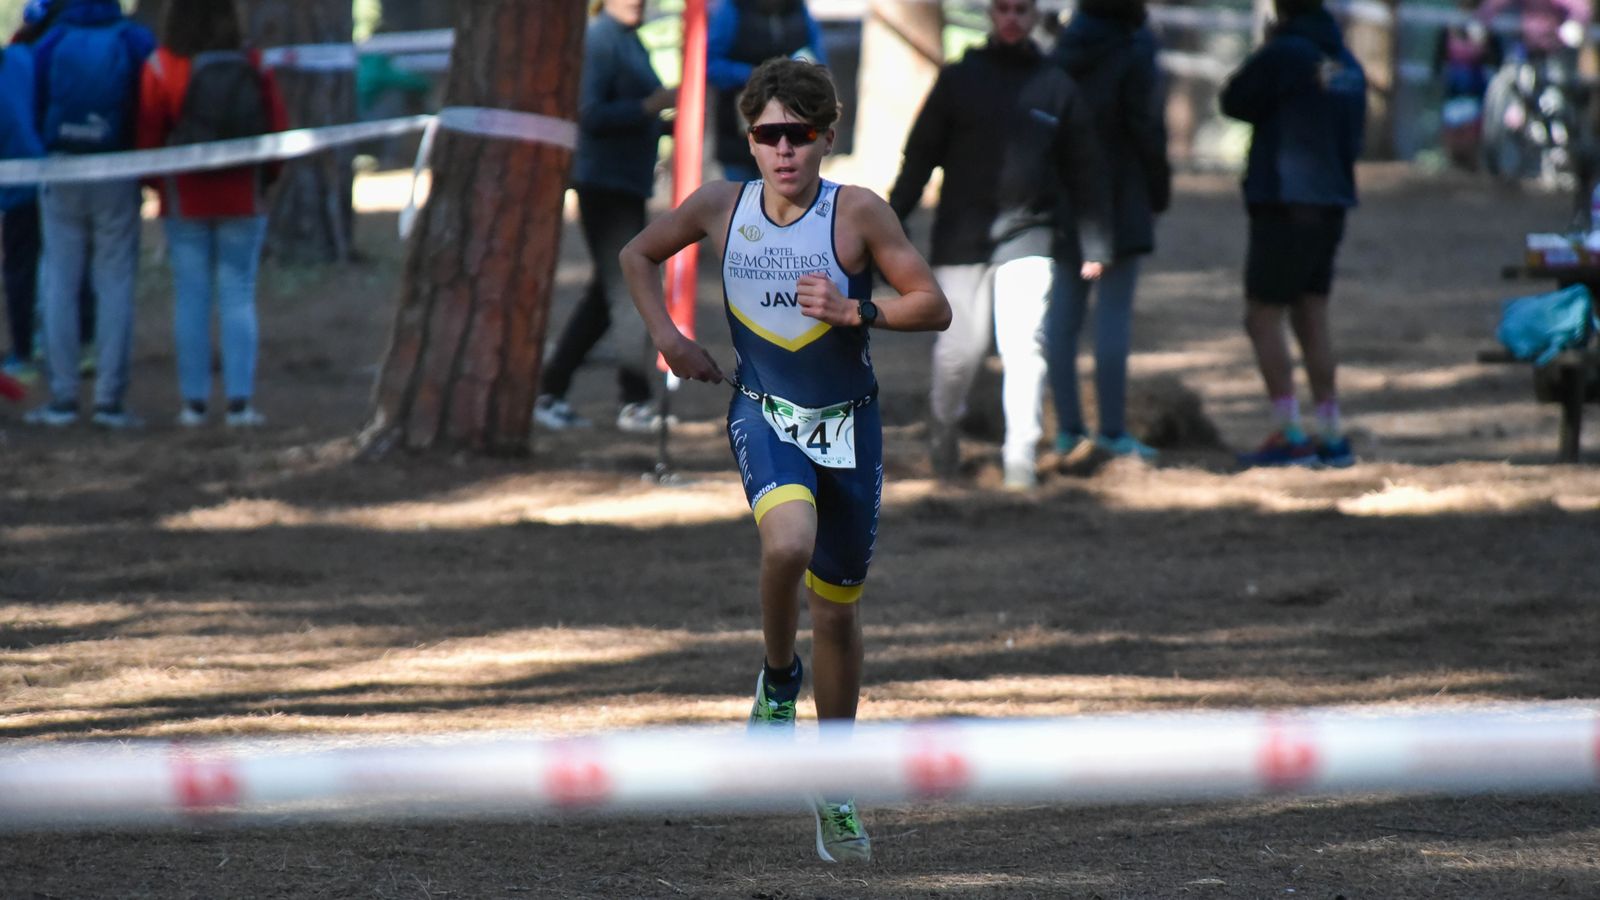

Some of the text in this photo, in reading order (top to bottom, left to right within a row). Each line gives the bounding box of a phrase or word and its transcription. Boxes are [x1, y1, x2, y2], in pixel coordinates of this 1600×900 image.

[764, 247, 794, 256] HOTEL
[728, 250, 829, 269] LOS MONTEROS
[728, 267, 777, 280] TRIATLON
[760, 292, 798, 307] JAV
[784, 421, 831, 454] 14
